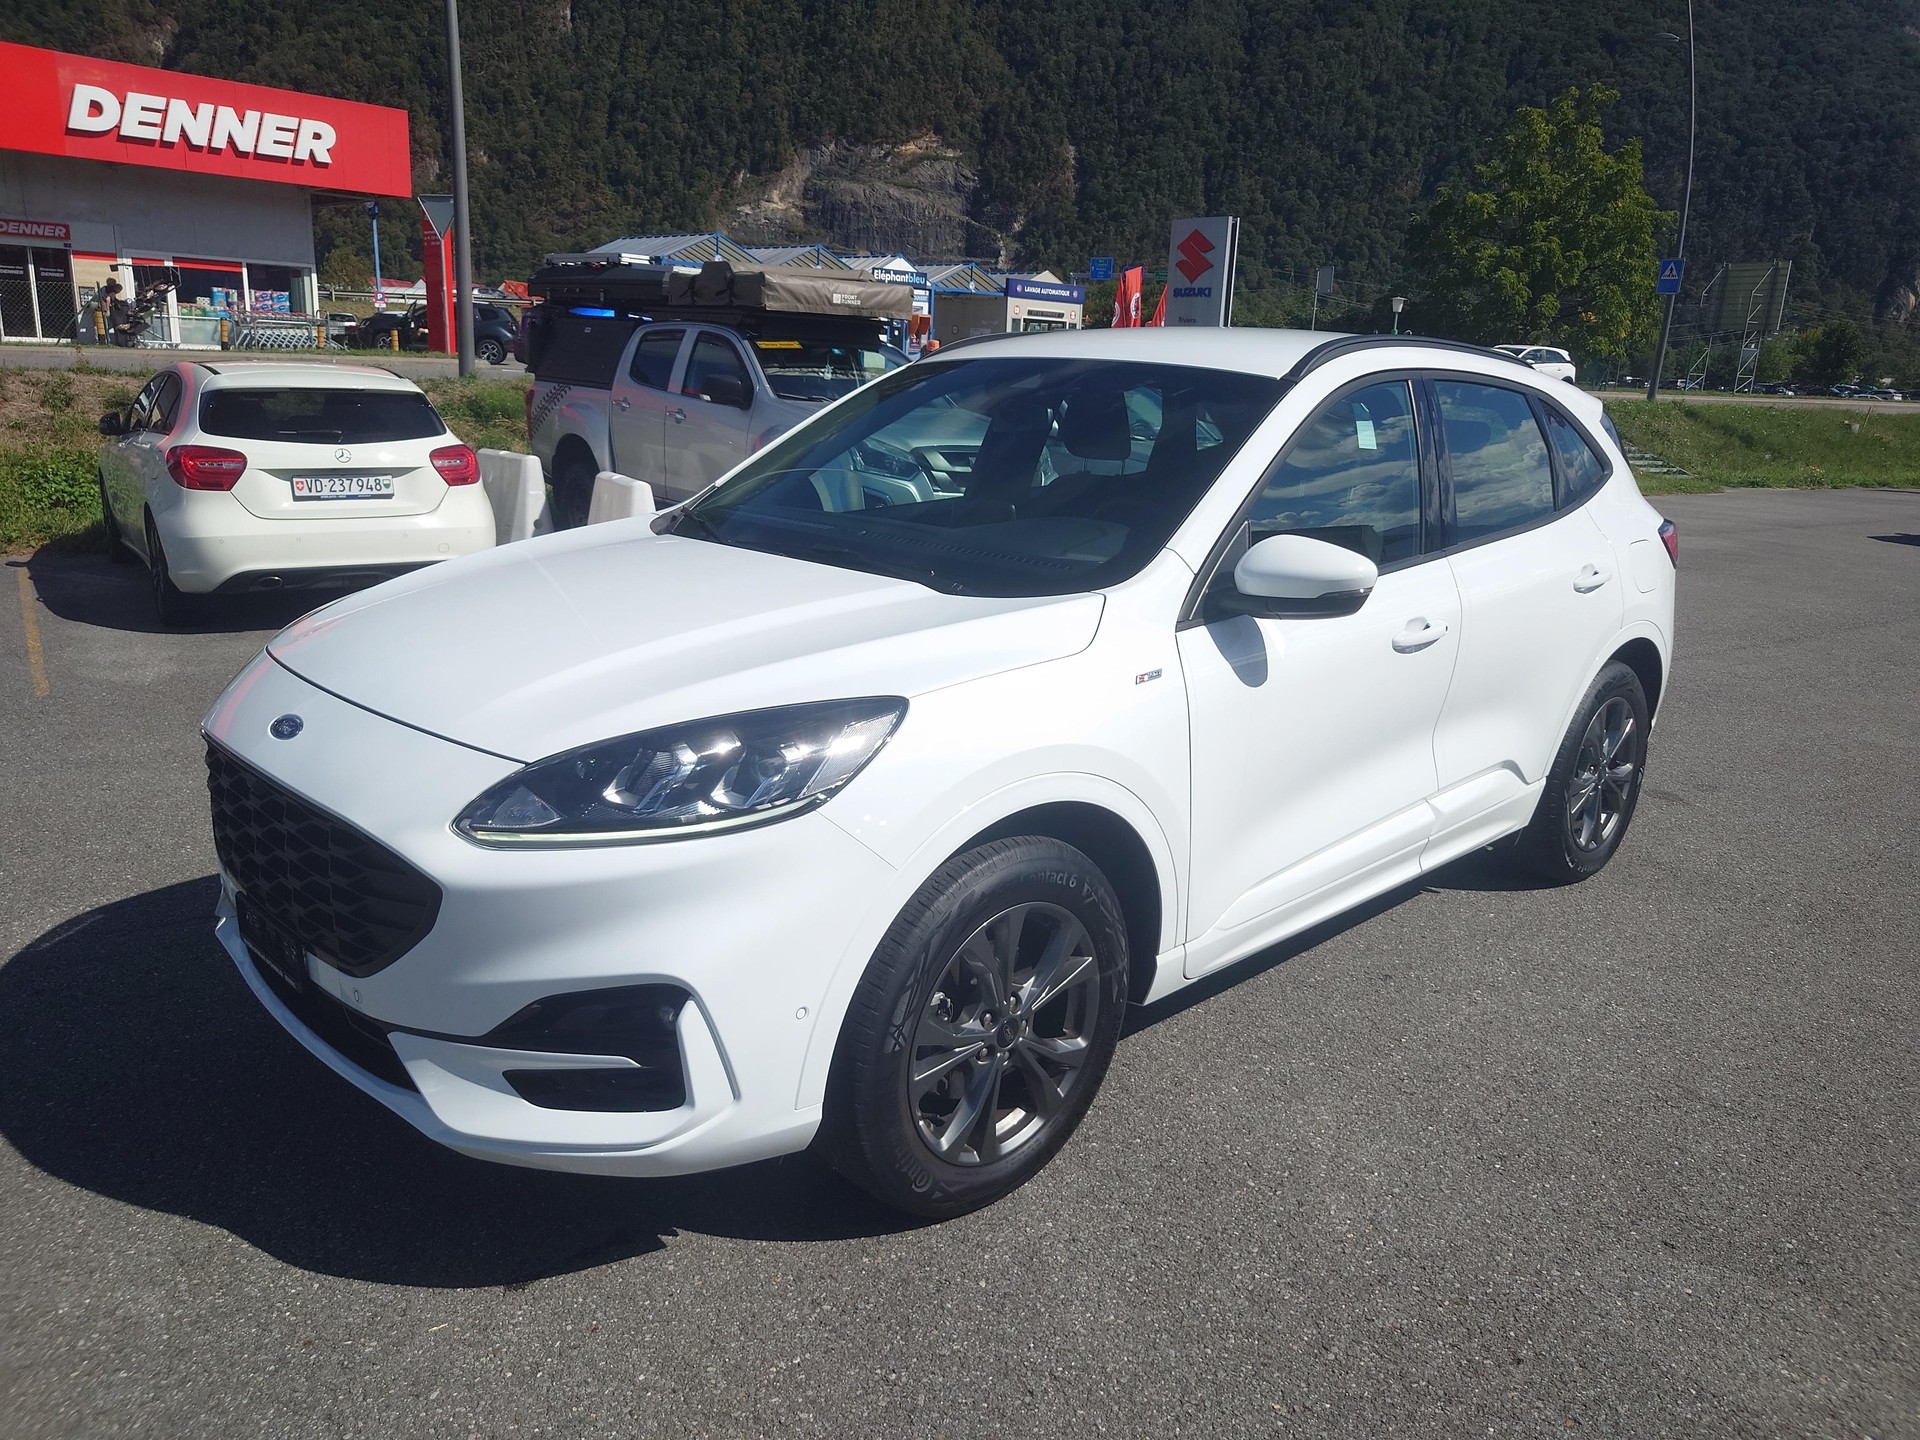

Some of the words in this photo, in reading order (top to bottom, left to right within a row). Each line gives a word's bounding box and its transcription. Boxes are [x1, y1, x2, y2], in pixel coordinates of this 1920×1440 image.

[67, 83, 337, 163] DENNER
[1024, 285, 1041, 294] LAVAGE
[1041, 288, 1070, 297] AUTOMATIQUE
[1173, 287, 1212, 298] SUZUKI
[1069, 873, 1078, 888] 6
